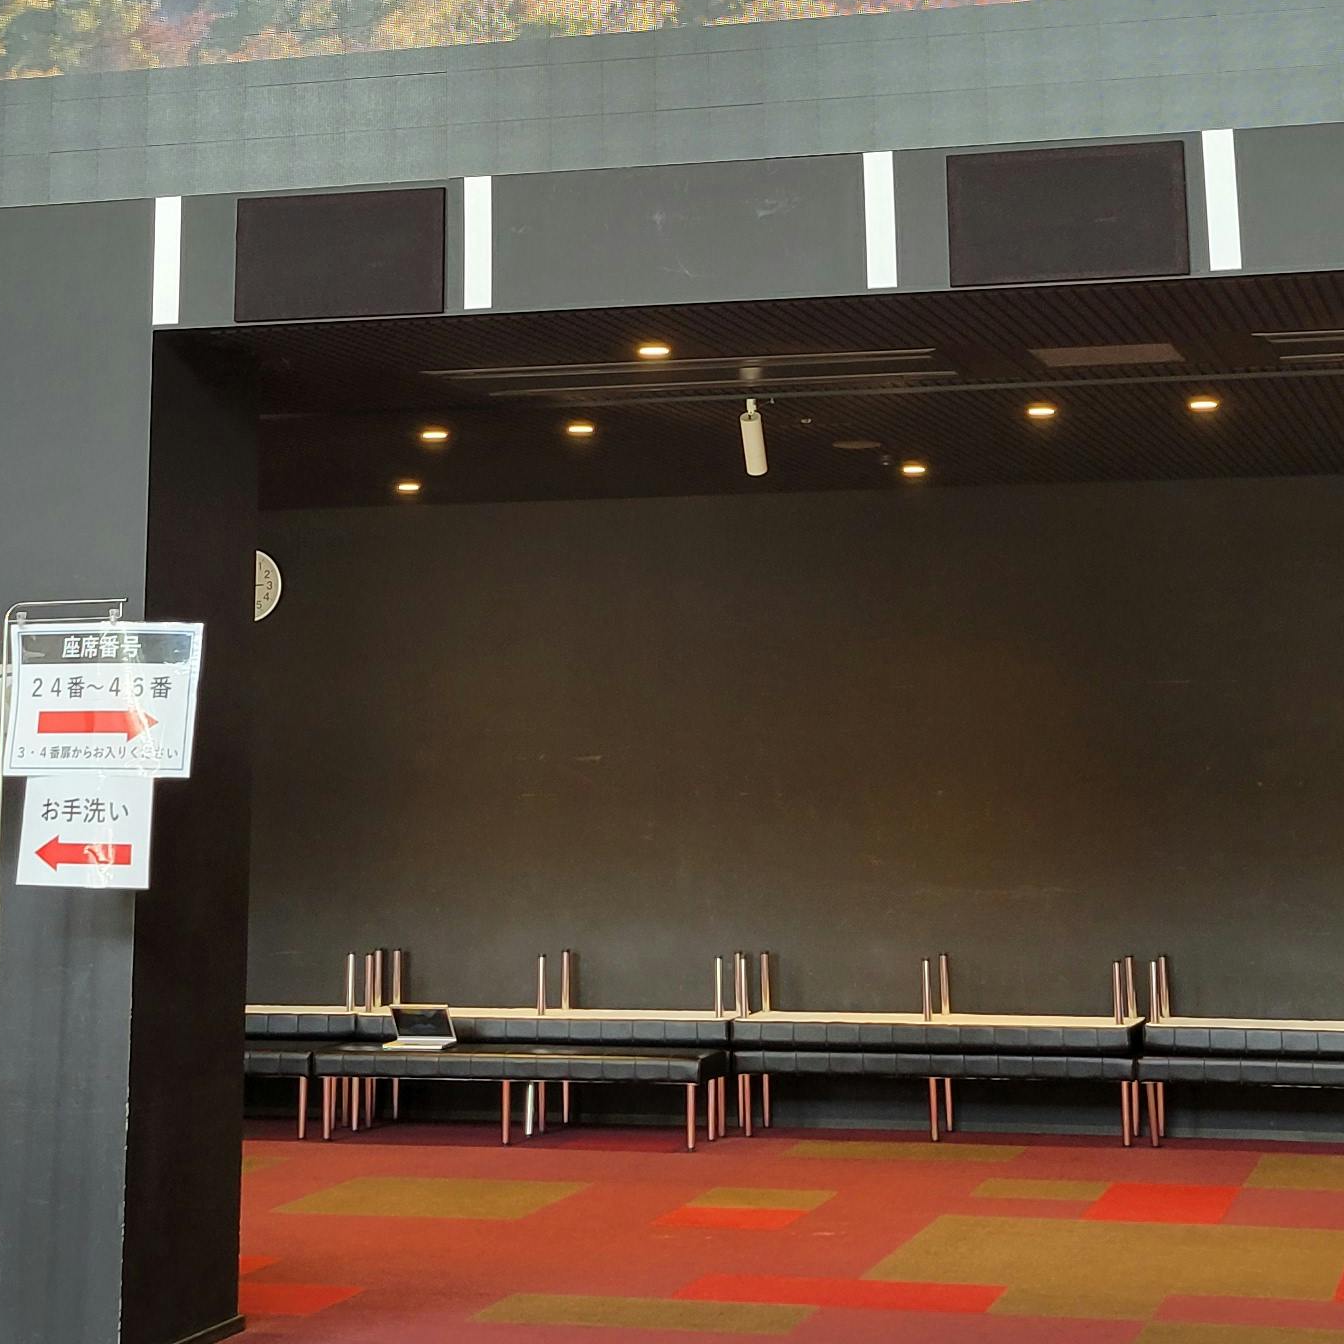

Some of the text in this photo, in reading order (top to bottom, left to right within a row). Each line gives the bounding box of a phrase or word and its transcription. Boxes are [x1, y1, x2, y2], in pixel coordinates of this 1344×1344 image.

[264, 570, 271, 579] 2
[266, 581, 273, 590] 3
[263, 592, 270, 601] 4
[256, 601, 263, 610] 5
[62, 635, 142, 659] 座席番号
[41, 798, 129, 823] お手洗い
